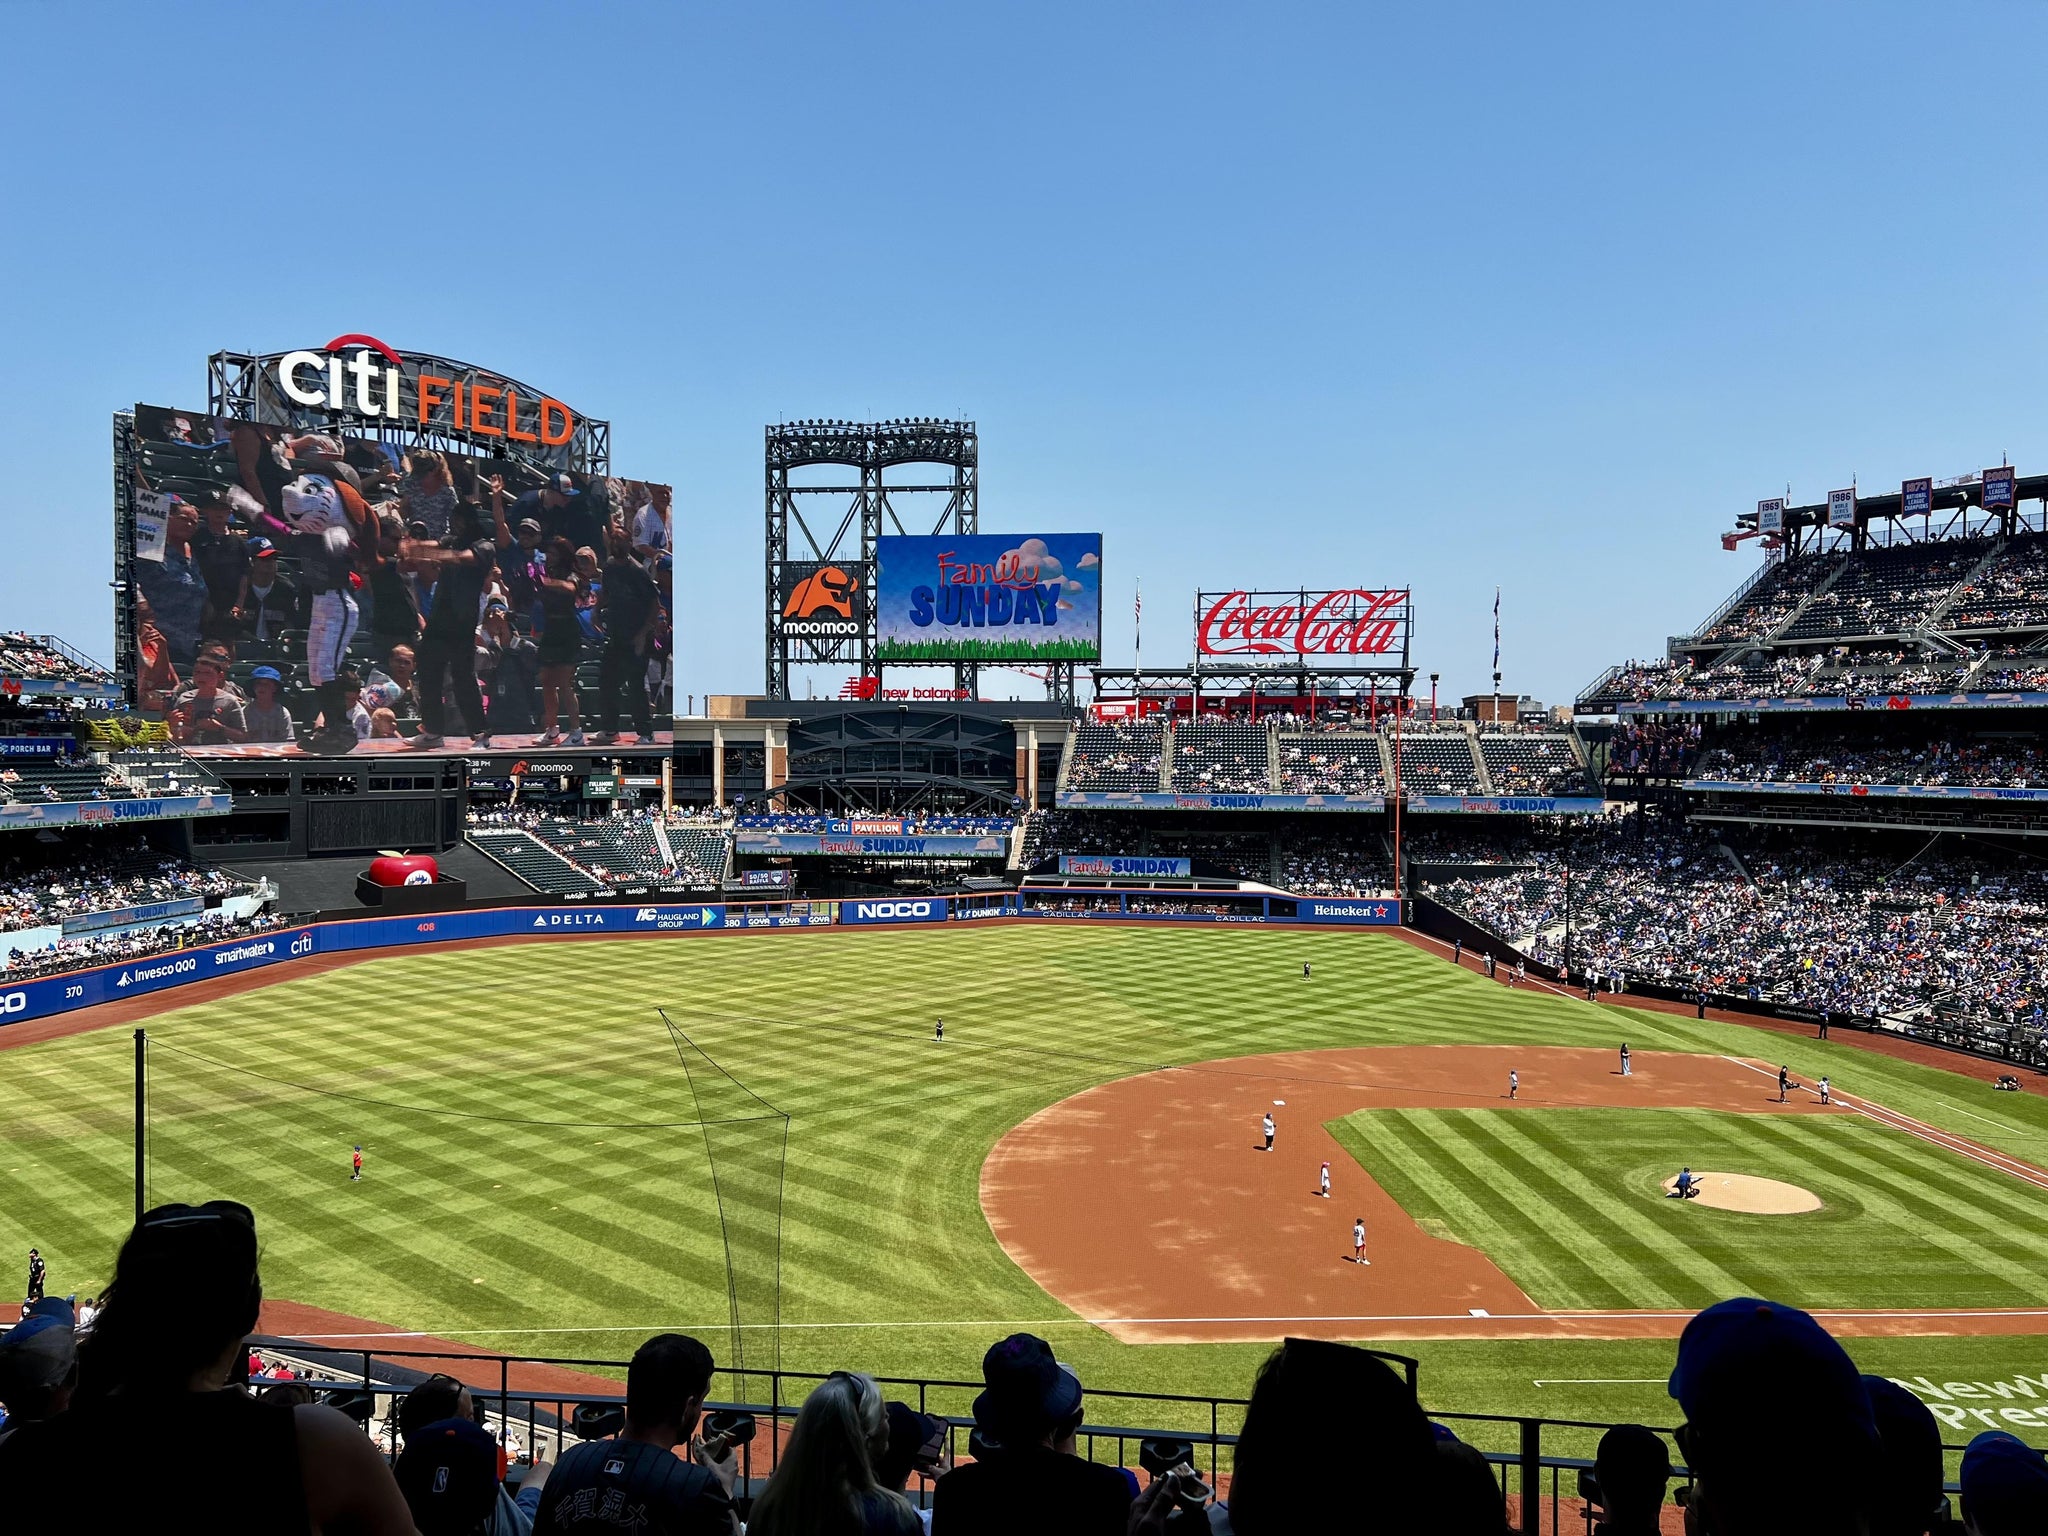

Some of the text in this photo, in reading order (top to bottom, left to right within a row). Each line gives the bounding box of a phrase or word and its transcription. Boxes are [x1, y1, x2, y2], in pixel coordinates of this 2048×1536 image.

[279, 350, 573, 446] citi FIELD
[1985, 471, 2012, 482] 2000
[1906, 482, 1928, 492] 1973
[1987, 482, 2009, 490] NATIONAL
[1832, 493, 1851, 502] 1986
[1985, 493, 2011, 502] CHAMPIONS
[1762, 502, 1780, 512] 1969
[1905, 503, 1929, 511] CHAMPIONS
[938, 552, 1040, 590] Family
[909, 583, 1061, 628] SUNDAY
[783, 621, 859, 634] moomoo
[882, 690, 909, 698] new
[912, 687, 969, 698] balance
[1996, 790, 2036, 800] SUNDAY
[1175, 796, 1265, 810] Family SUNDAY
[1461, 798, 1556, 812] Family SUNDAY
[78, 801, 162, 822] Family SUNDAY
[832, 820, 899, 834] citi PAVILION
[820, 838, 926, 854] Family SUNDAY
[1067, 857, 1179, 875] Family SUNDAY
[134, 905, 168, 919] SUNDAY
[857, 902, 931, 918] NOCO
[1314, 904, 1371, 917] Heineken
[552, 914, 604, 924] DELTA
[657, 913, 700, 921] HAUGLAND
[724, 919, 740, 928] 380
[417, 922, 435, 932] 408
[290, 935, 312, 954] citi
[216, 942, 267, 965] smartwater
[135, 958, 196, 983] Invesco QQQ
[65, 984, 83, 999] 370
